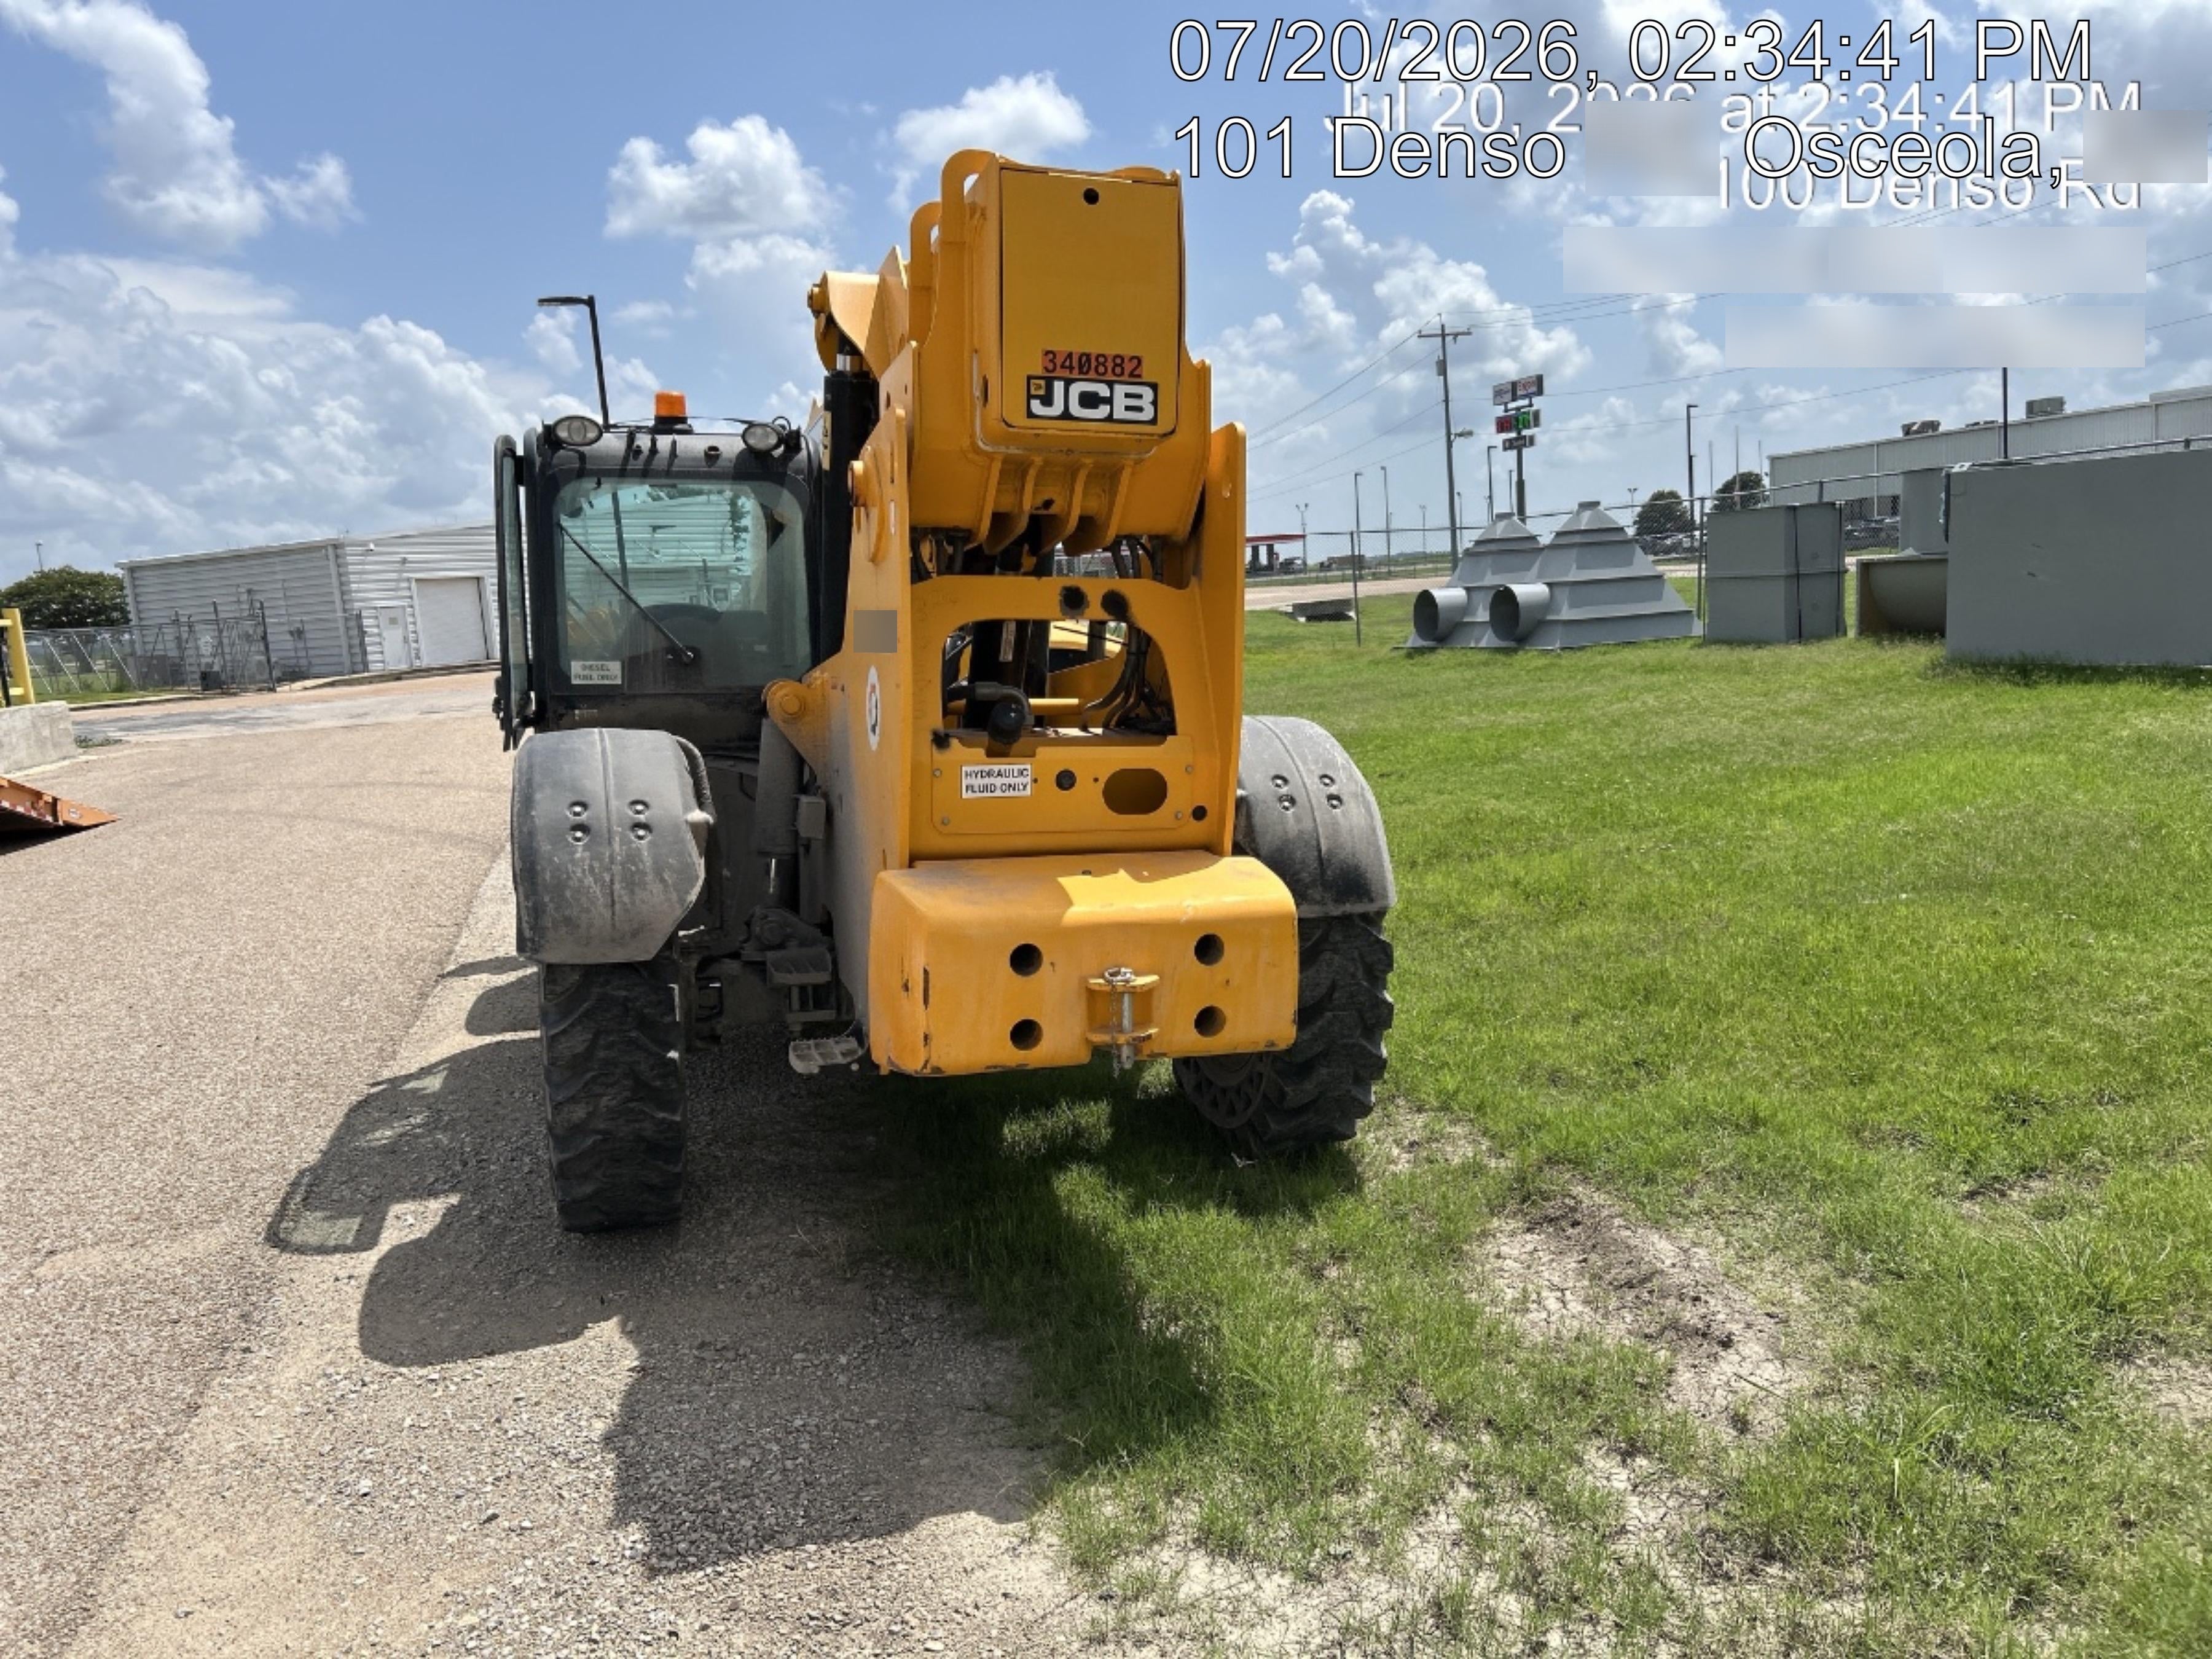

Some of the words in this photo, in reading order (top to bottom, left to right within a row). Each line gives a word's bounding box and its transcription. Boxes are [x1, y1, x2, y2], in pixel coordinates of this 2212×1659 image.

[1043, 350, 1142, 378] 340882
[1030, 379, 1155, 422] JCB
[964, 767, 1030, 780] HYDRAULIC
[965, 783, 997, 794] FLUID
[1000, 781, 1029, 793] ONLY
